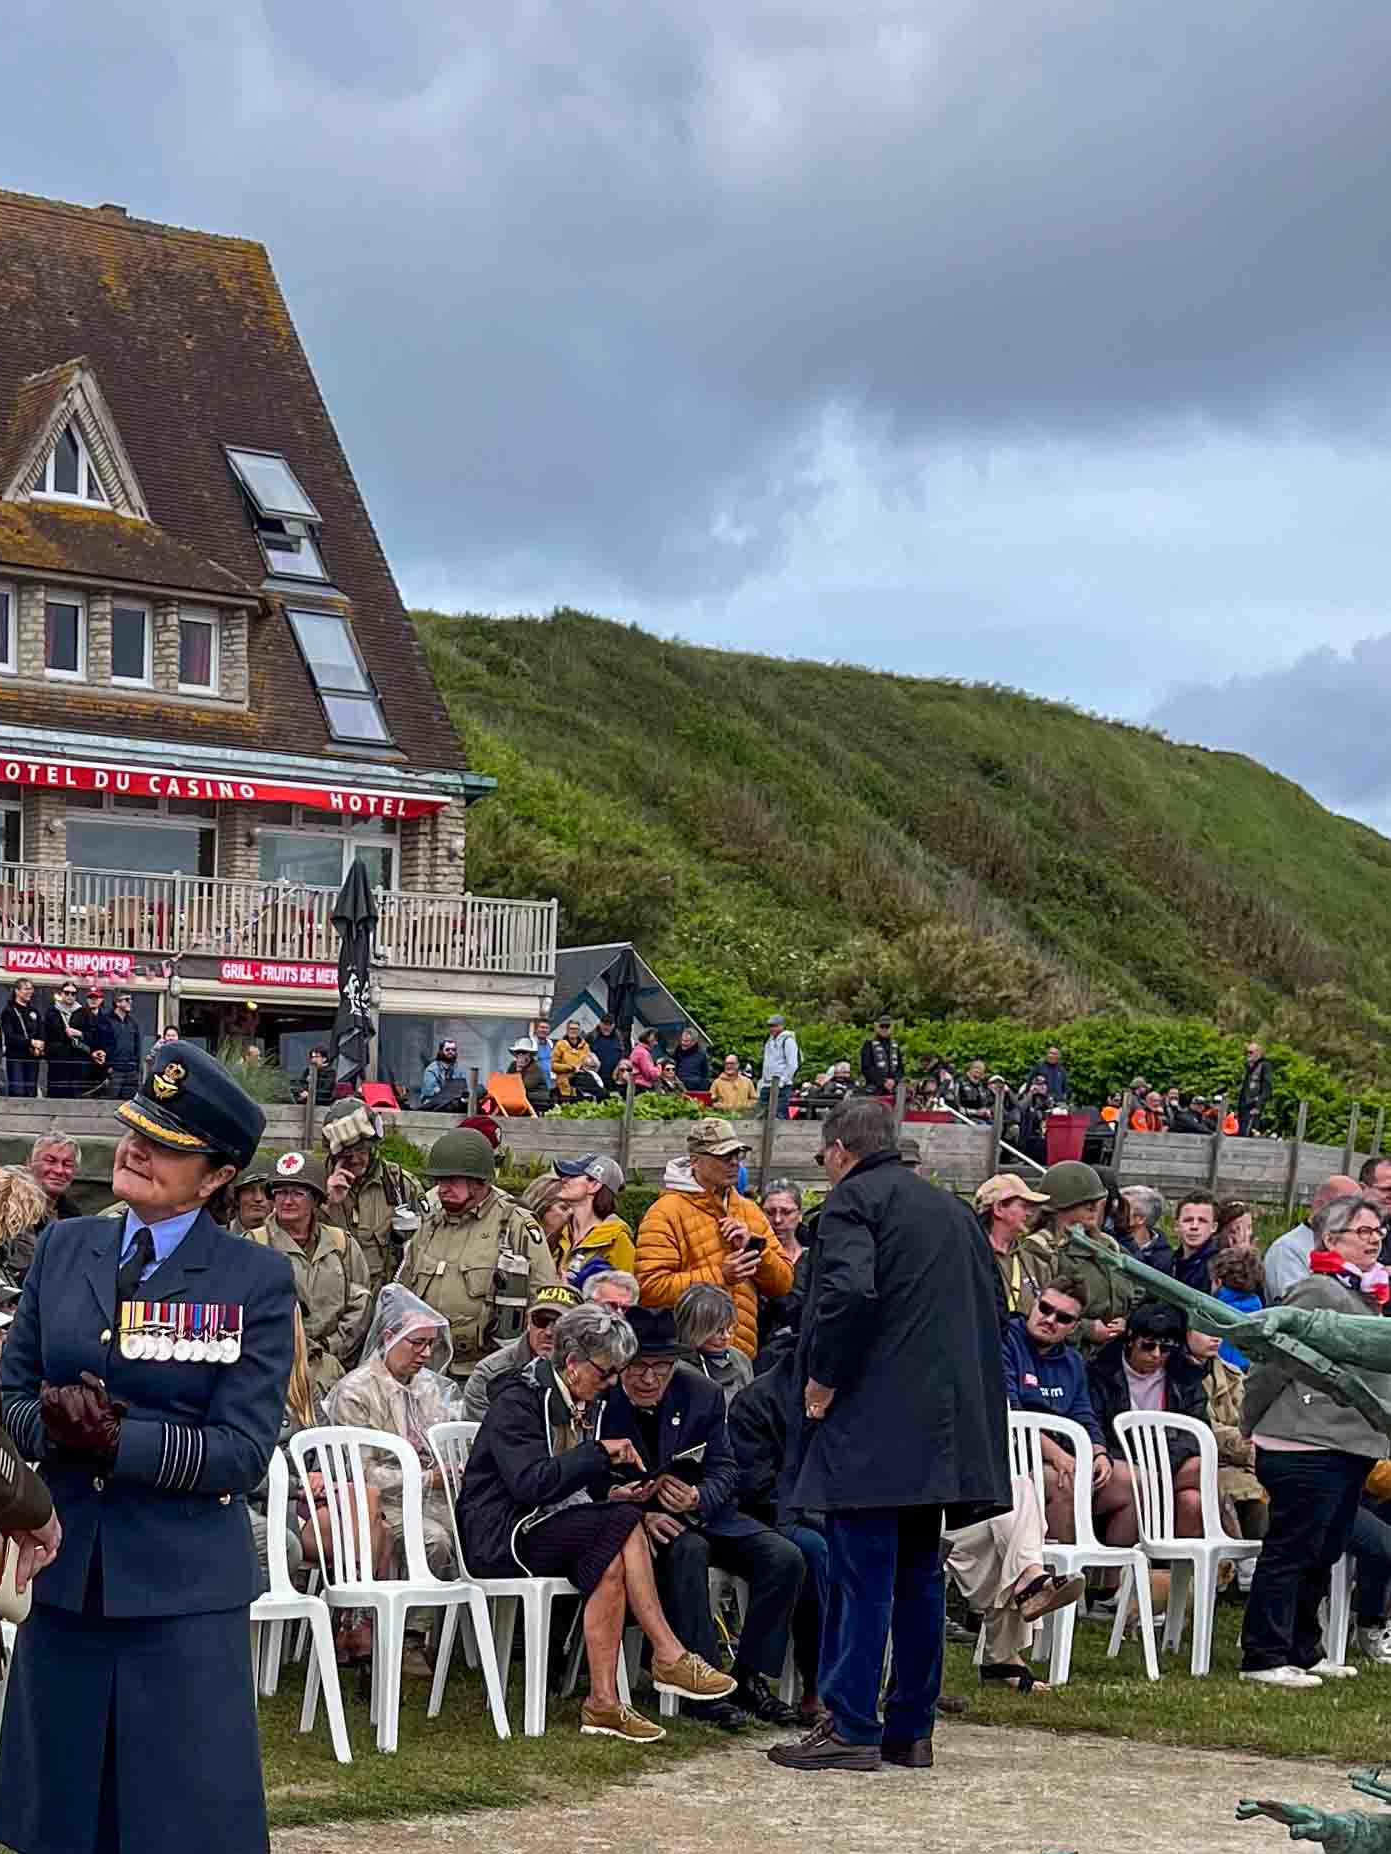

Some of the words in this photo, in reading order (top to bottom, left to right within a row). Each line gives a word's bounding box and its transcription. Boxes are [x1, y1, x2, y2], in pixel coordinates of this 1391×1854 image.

[95, 771, 130, 790] DU
[149, 776, 255, 798] CASINO
[330, 792, 405, 816] HOTEL
[8, 950, 50, 969] PIZZAS
[66, 953, 131, 972] EMPORTER
[222, 962, 254, 980] GRILL
[261, 966, 298, 983] FRUITS
[300, 968, 315, 984] DE
[316, 968, 339, 985] MER
[537, 1287, 574, 1304] AC/DC
